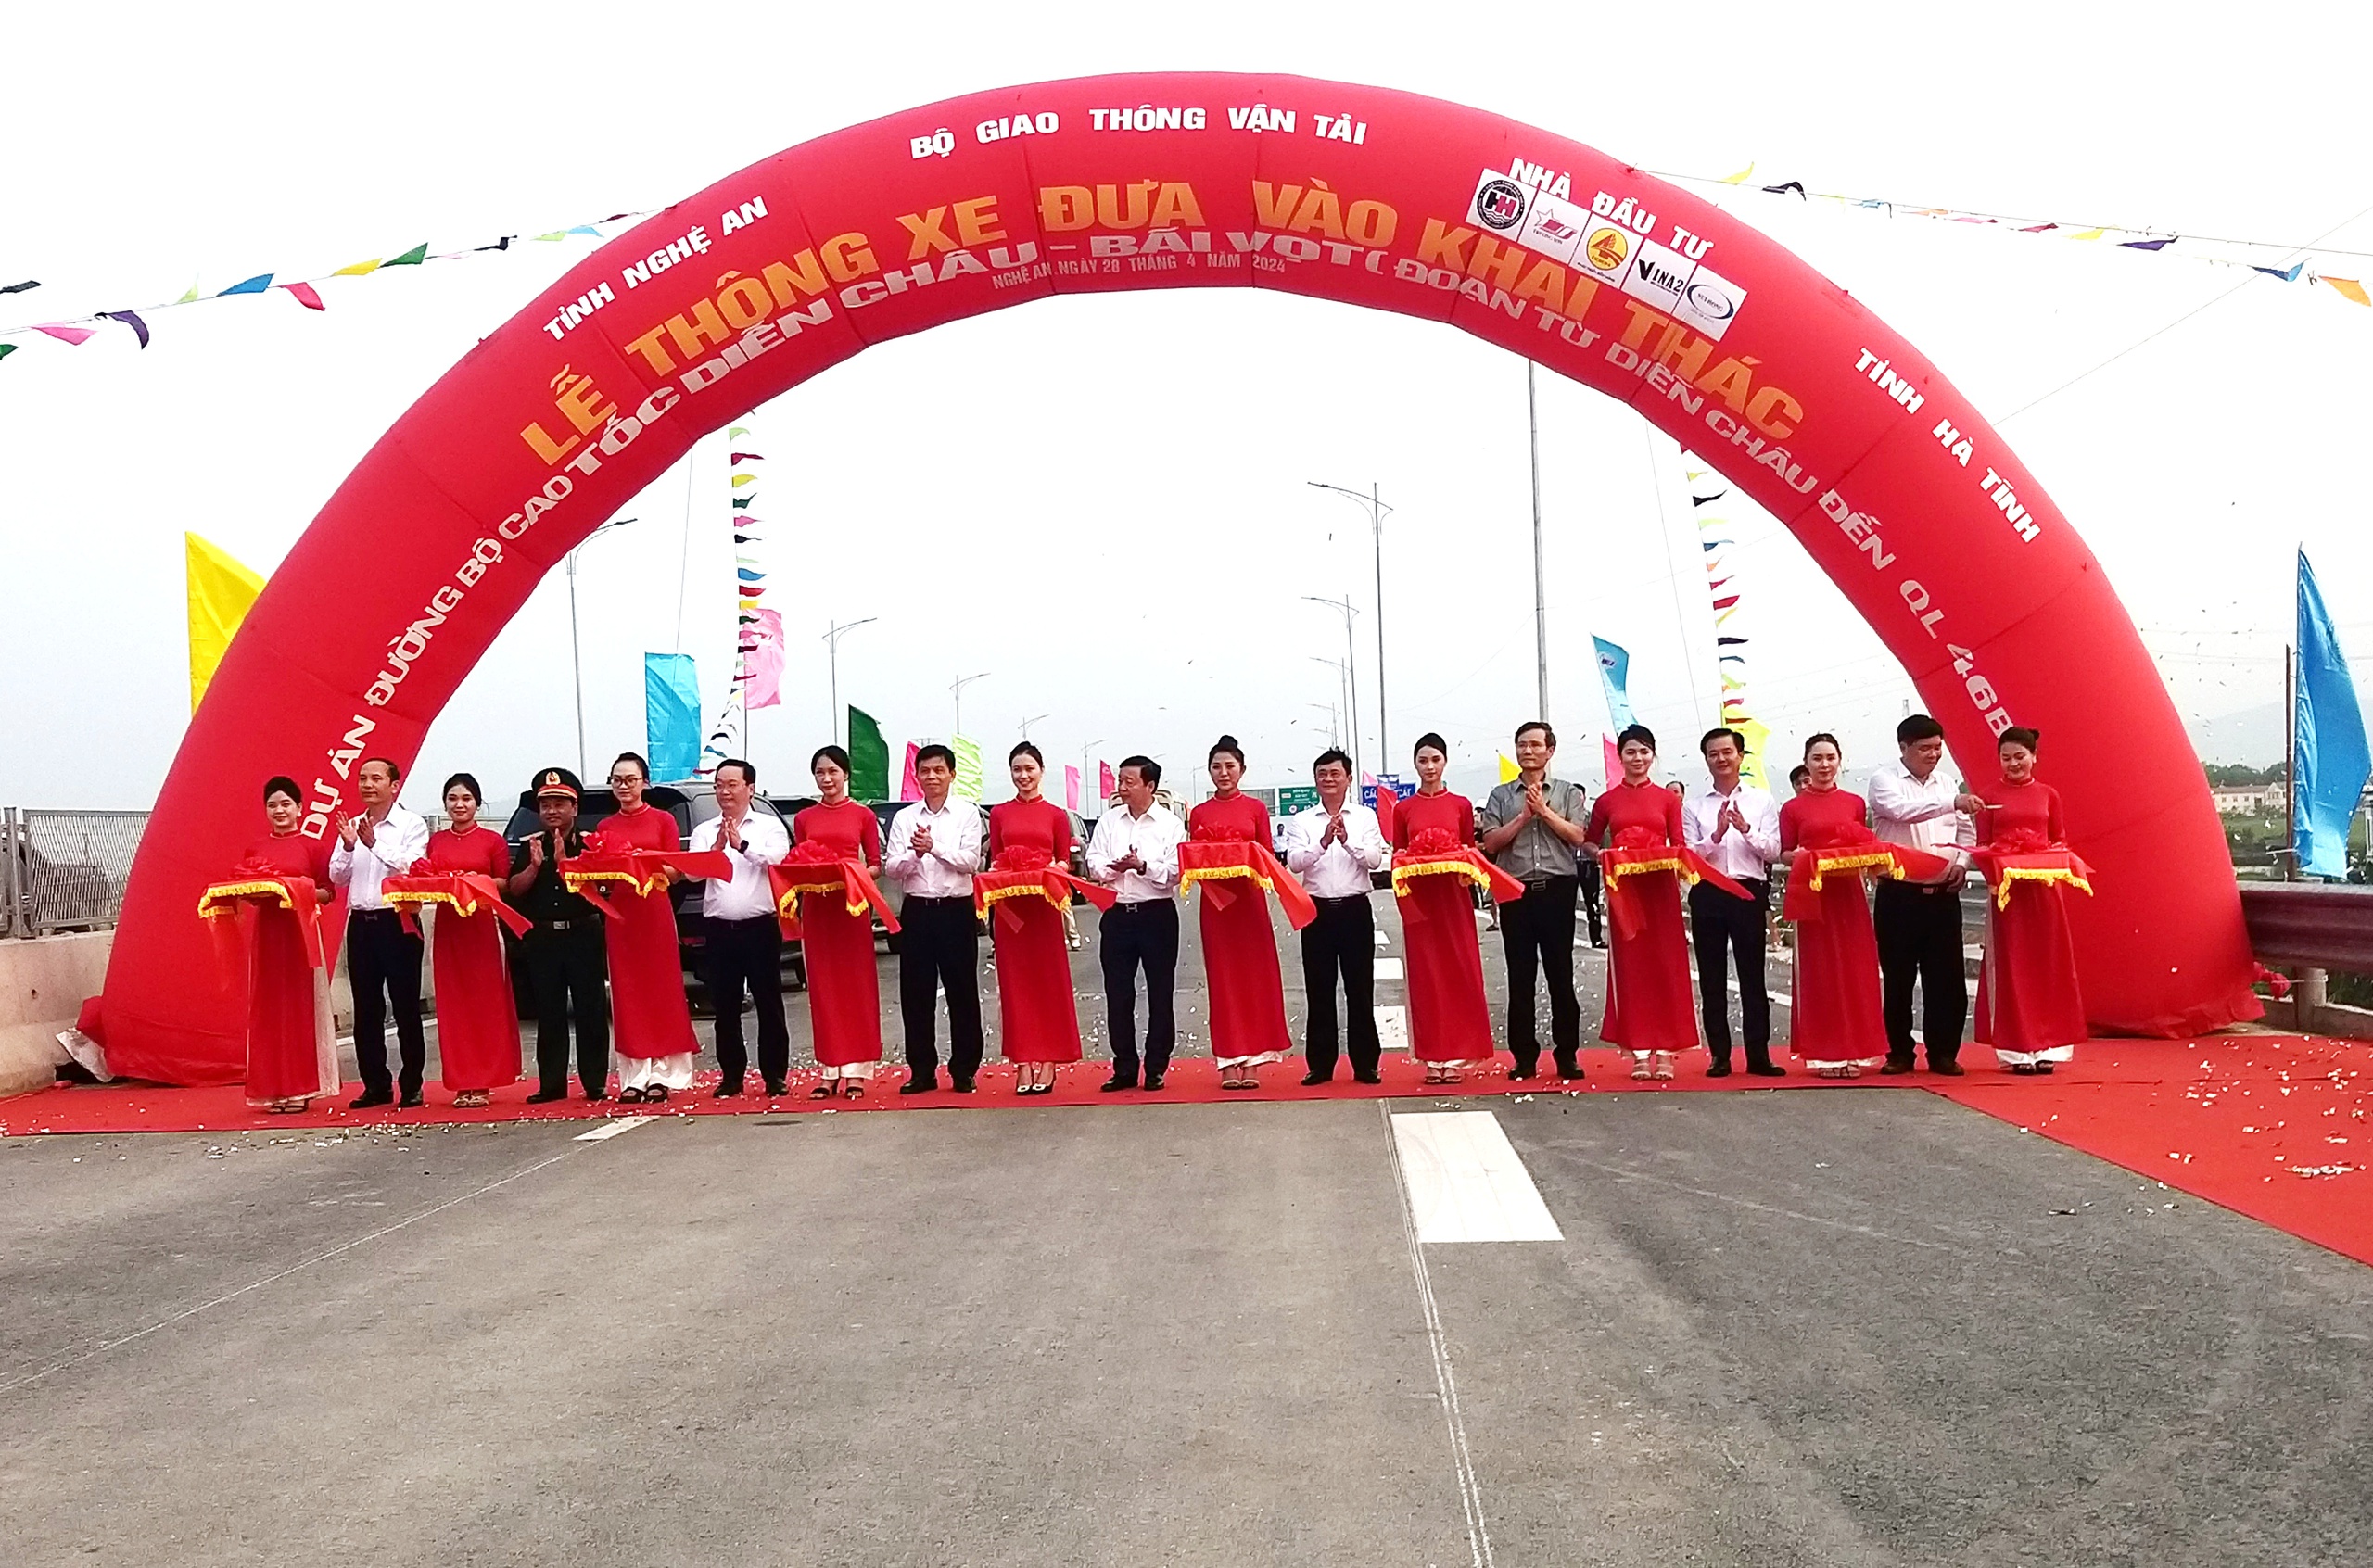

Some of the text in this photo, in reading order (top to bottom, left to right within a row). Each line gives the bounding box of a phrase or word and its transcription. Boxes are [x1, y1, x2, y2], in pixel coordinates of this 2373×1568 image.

[910, 127, 956, 159] BỘ
[975, 112, 1060, 144] GIAO
[1227, 103, 1296, 133] VẬN
[1313, 113, 1367, 145] TẢI
[542, 196, 768, 341] TỈNH NGHỆ AN
[992, 265, 1032, 289] NGHỆ
[1058, 257, 1098, 275] NGÀY
[1127, 254, 1177, 272] THÁNG
[1186, 253, 1197, 267] 4
[1207, 251, 1241, 268] NĂM
[1252, 254, 1286, 273] 2024
[1508, 157, 1715, 260] NHÀ ĐẦU TƯ
[520, 177, 1804, 466] LỄ THÔNG XE ĐƯA VÀO KHAI THÁC
[1854, 347, 2041, 543] TỈNH HÀ TĨNH
[300, 778, 344, 841] DỰ
[326, 714, 376, 781] ÁN
[363, 585, 465, 706] ĐƯỜNG
[454, 537, 504, 588] BỘ
[498, 475, 573, 540] CAO
[564, 386, 681, 476] TỐC
[839, 241, 1038, 309] CHÂU
[1090, 226, 1211, 257] BÃI
[1534, 305, 1601, 348] TỪ
[1705, 409, 1818, 494] CHÂU
[1818, 488, 1897, 571] ĐẾN
[1899, 579, 1945, 639] QL
[1946, 643, 2014, 739] 46B
